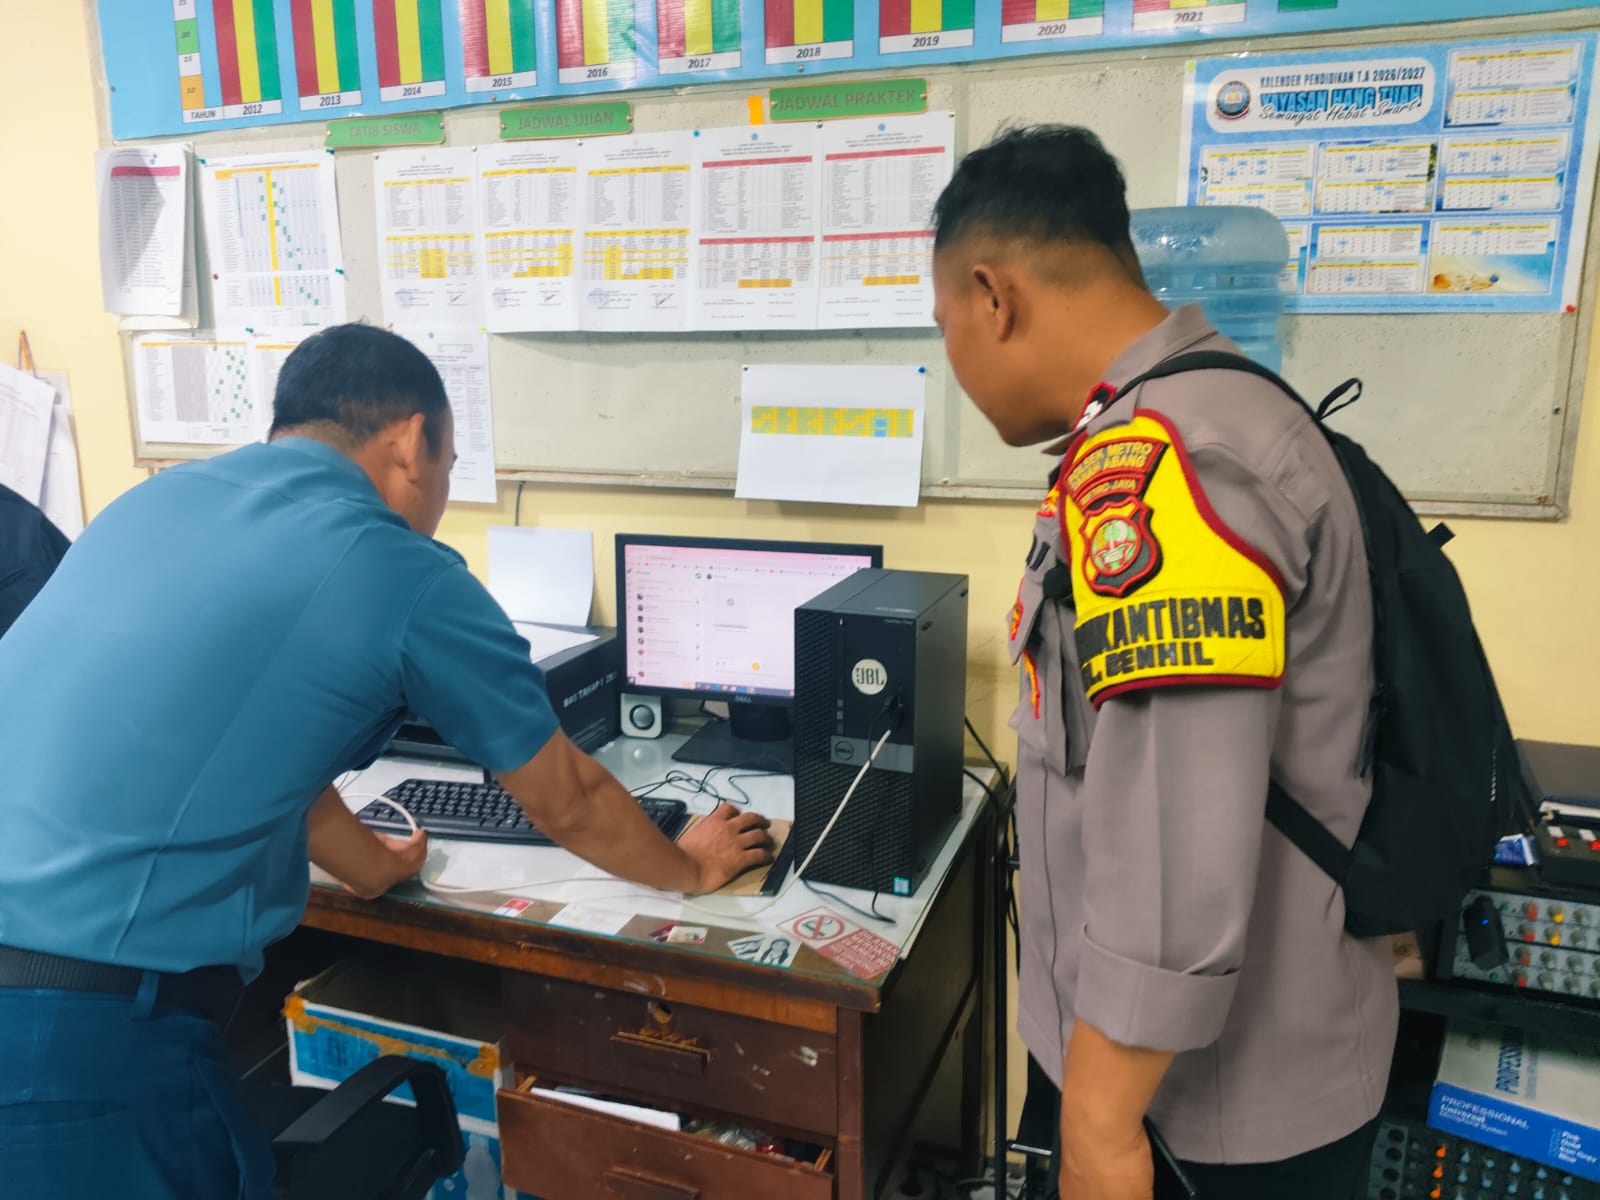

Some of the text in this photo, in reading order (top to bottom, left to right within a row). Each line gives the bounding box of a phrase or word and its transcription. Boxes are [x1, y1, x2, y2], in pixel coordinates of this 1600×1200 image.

[1174, 10, 1204, 24] 2021
[1037, 23, 1067, 36] 2020
[912, 35, 940, 47] 2019
[796, 47, 821, 59] 2018
[687, 57, 711, 69] 2017
[586, 67, 608, 79] 2016
[492, 76, 512, 88] 2015
[1260, 74, 1301, 88] KALENDER
[402, 86, 422, 98] 2014
[1260, 84, 1423, 112] YAYASAN HANG TUAH
[319, 95, 342, 107] 2013
[778, 88, 916, 112] JADWAL PRAKTEK
[190, 110, 216, 120] TAHUN
[242, 104, 263, 116] 2012
[1259, 96, 1420, 126] Semangat Hebat Smart
[517, 111, 614, 131] JADWAL UJIAN
[349, 123, 421, 138] TATIB SISWA
[1106, 442, 1153, 457] METRO
[1105, 642, 1214, 676] BENHIL
[856, 667, 885, 686] JBL
[1441, 1095, 1529, 1130] PROFESSIONAL
[1441, 1104, 1486, 1123] Universal
